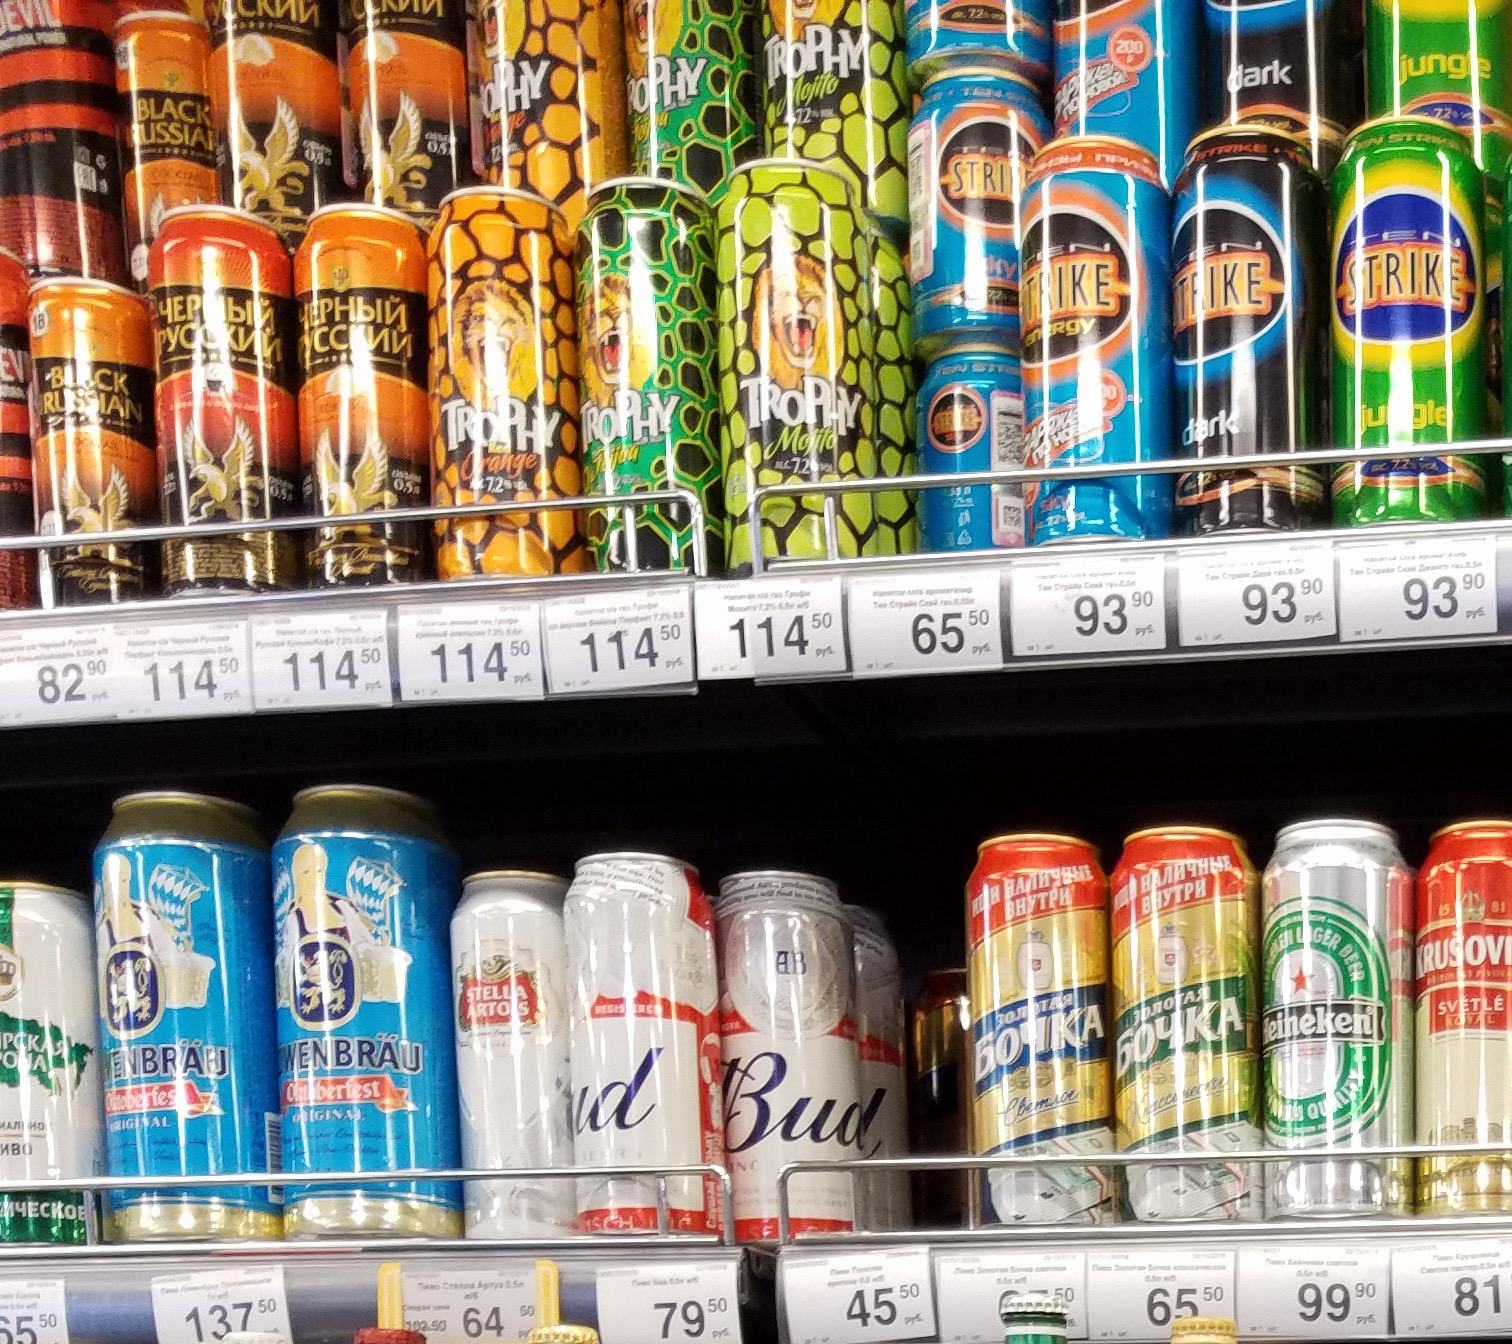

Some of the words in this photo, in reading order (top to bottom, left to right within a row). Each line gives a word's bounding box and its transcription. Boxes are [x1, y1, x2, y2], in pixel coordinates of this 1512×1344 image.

[1228, 59, 1292, 92] dark
[1399, 53, 1491, 84] jungle
[441, 400, 558, 452] TROPHY
[581, 395, 680, 453] TROPHY
[742, 378, 861, 432] TROPHY
[769, 425, 839, 455] Mojito
[1074, 594, 1128, 638] 93
[1131, 591, 1154, 609] 90
[1404, 576, 1458, 620] 93
[1461, 574, 1485, 592] 90
[912, 614, 965, 654] 65
[968, 609, 989, 628] 50
[145, 662, 217, 701] 114
[219, 658, 240, 675] 50
[432, 644, 508, 684] 114
[509, 641, 530, 659] 50
[466, 984, 526, 1006] STELLA
[975, 1005, 1105, 1082] БОЧКА
[1116, 997, 1244, 1078] БОЧКА
[1298, 1286, 1350, 1324] 99
[1354, 1282, 1376, 1300] 90
[1455, 1278, 1501, 1316] 81
[654, 1303, 705, 1339] 79
[708, 1299, 728, 1316] 50
